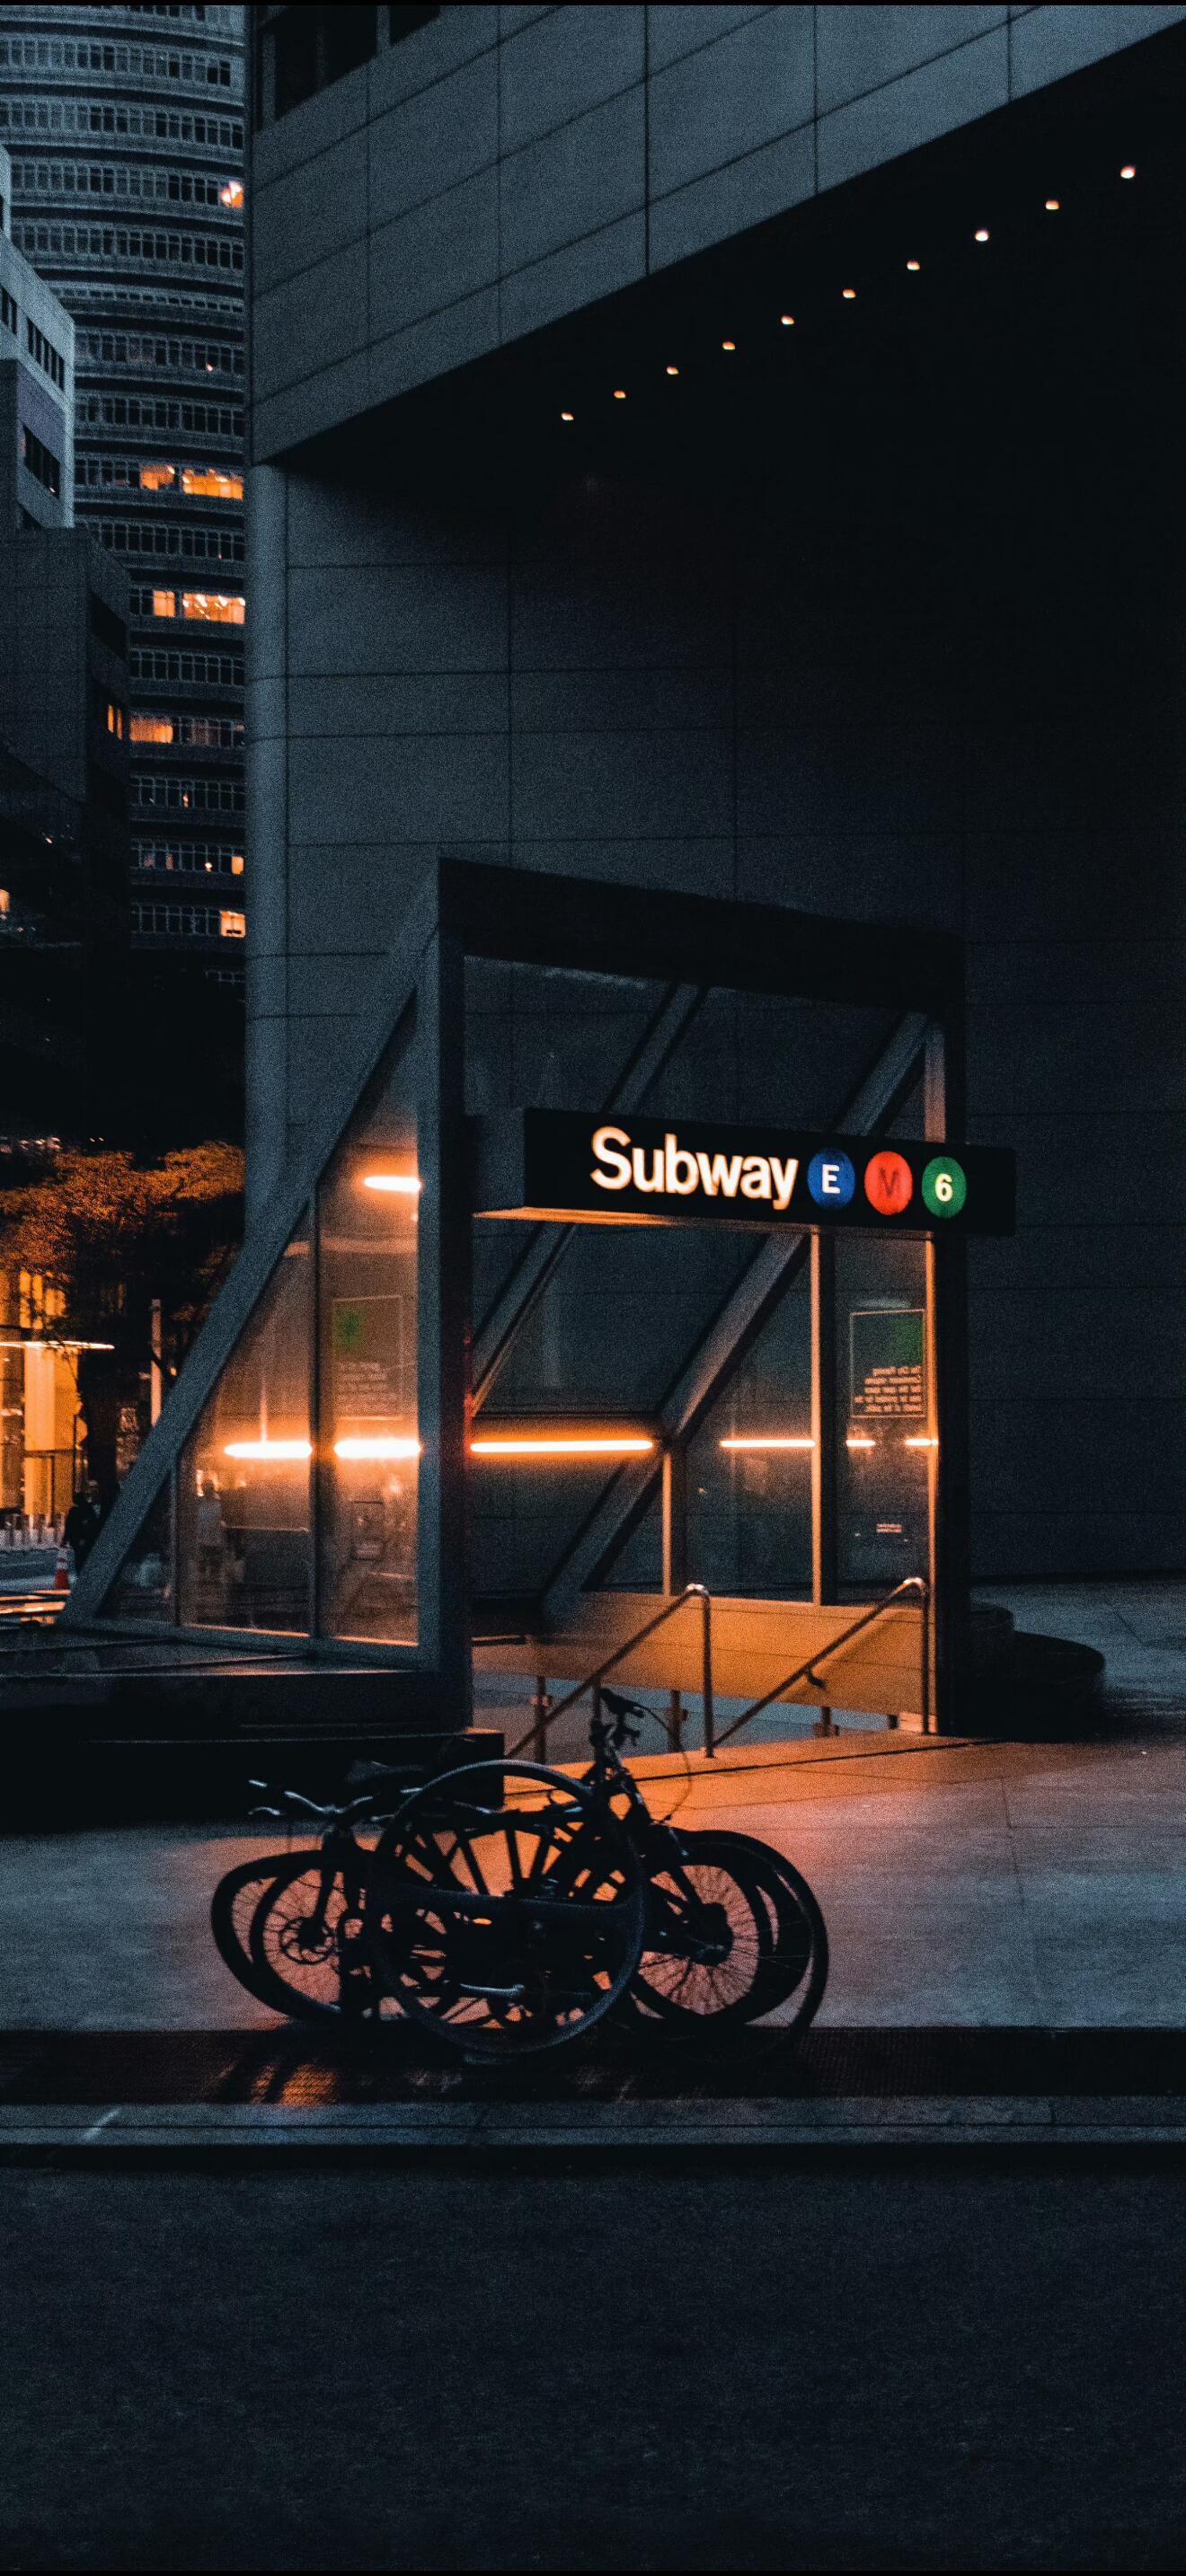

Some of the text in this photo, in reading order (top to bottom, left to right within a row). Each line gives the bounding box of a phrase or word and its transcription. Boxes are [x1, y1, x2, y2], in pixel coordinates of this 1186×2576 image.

[590, 1125, 798, 1210] Subway
[821, 1164, 841, 1195] E
[935, 1173, 953, 1203] 6
